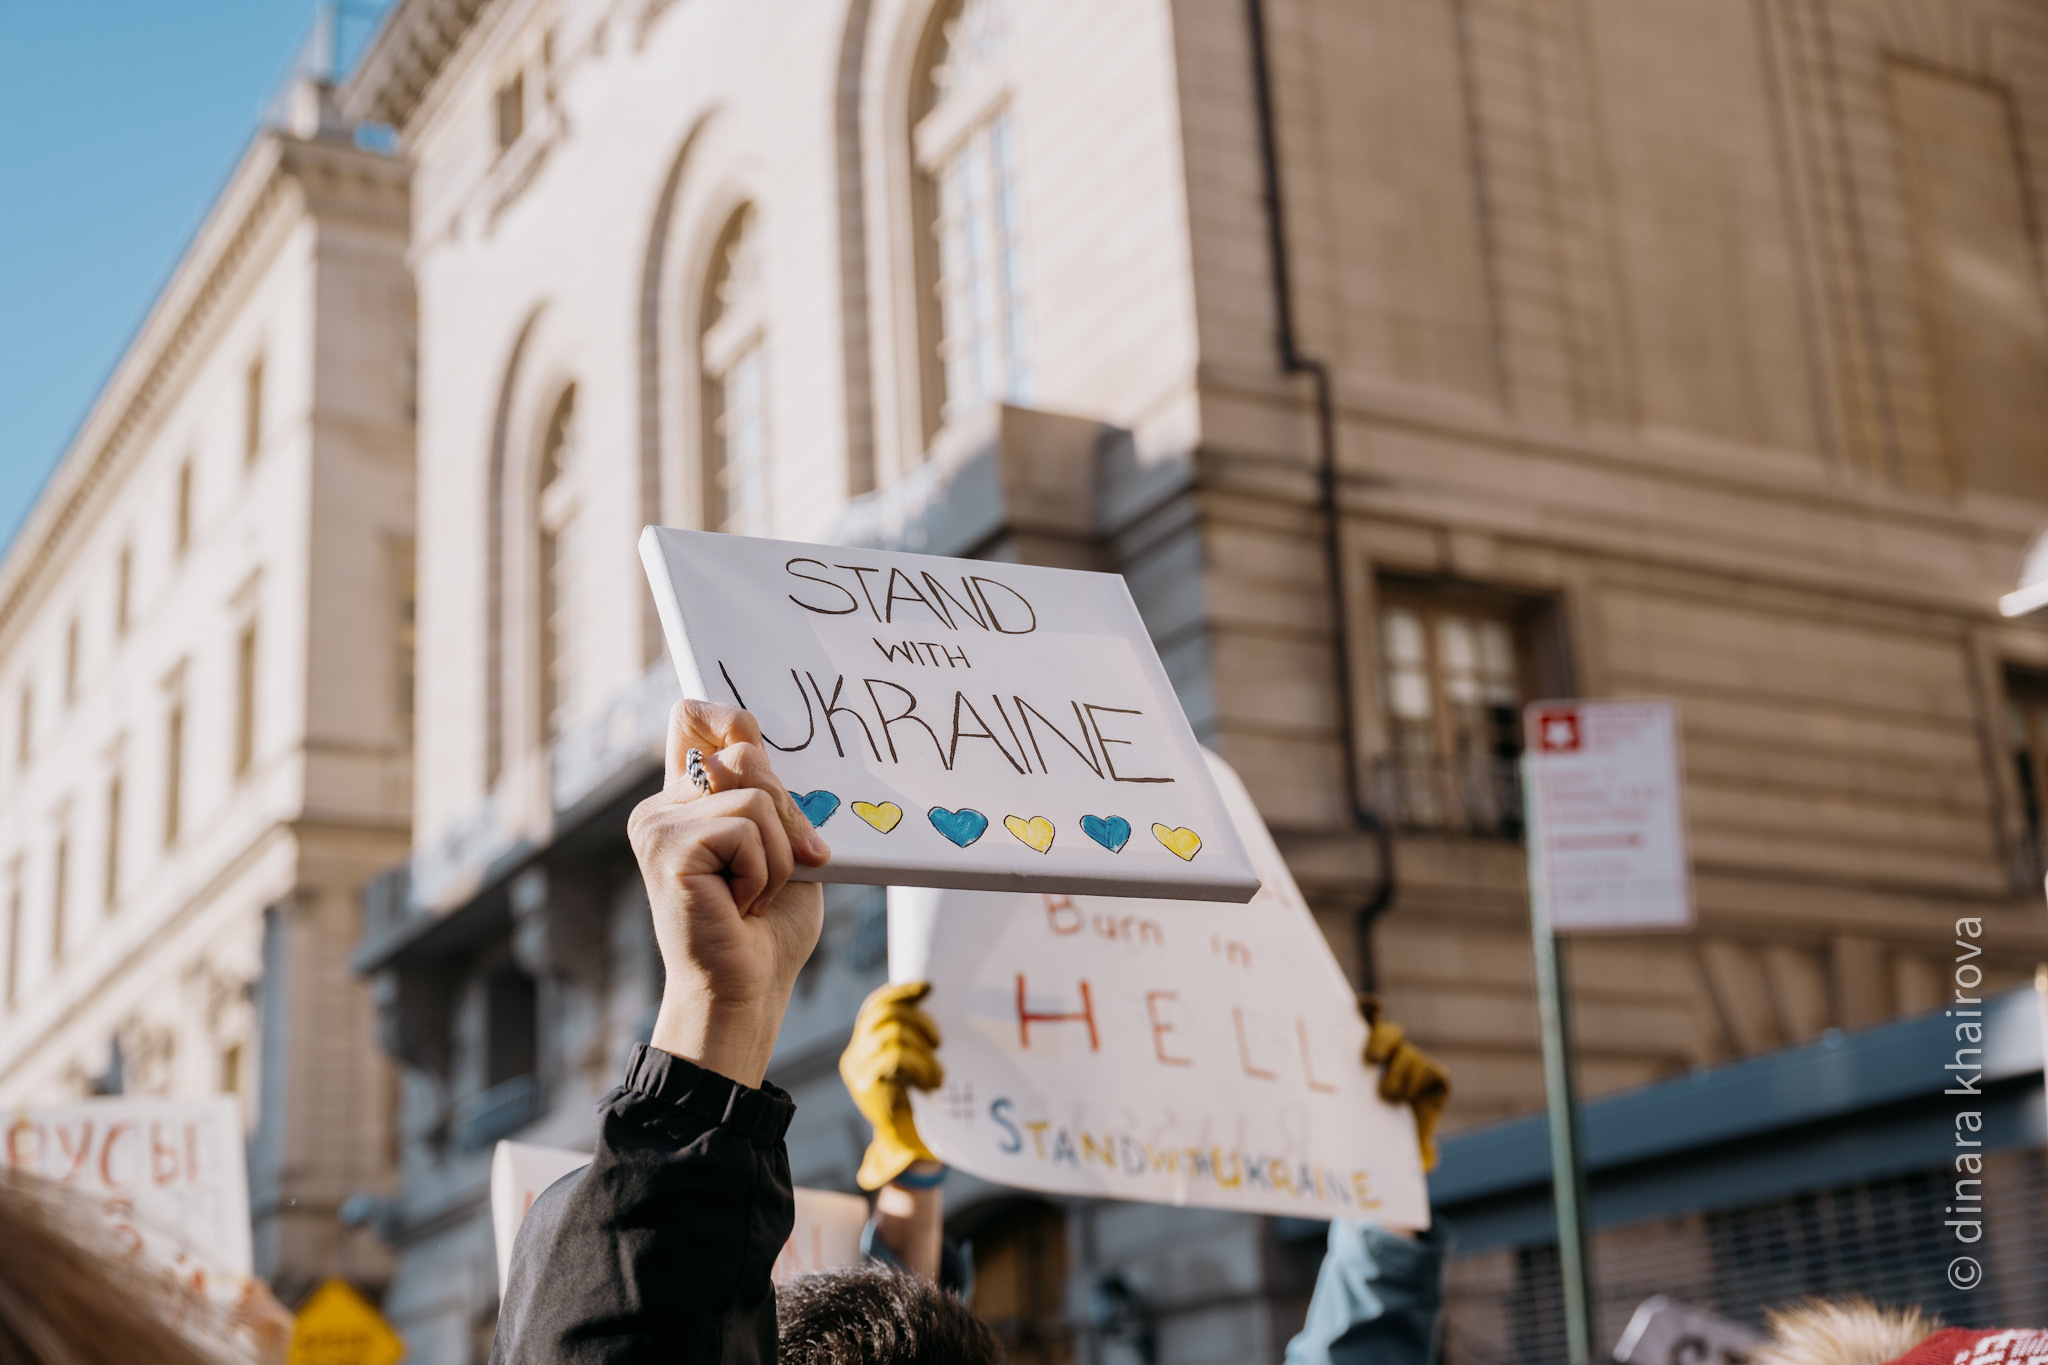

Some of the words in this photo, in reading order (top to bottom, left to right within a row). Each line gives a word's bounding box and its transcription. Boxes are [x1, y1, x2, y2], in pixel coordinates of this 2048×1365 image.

[785, 557, 1037, 634] STAND
[873, 636, 971, 668] WITH
[718, 660, 1175, 783] UKRAINE
[1042, 894, 1164, 945] Burn
[1014, 973, 1339, 1095] HELL
[945, 1083, 1383, 1210] #STANDWTHUKRAINE
